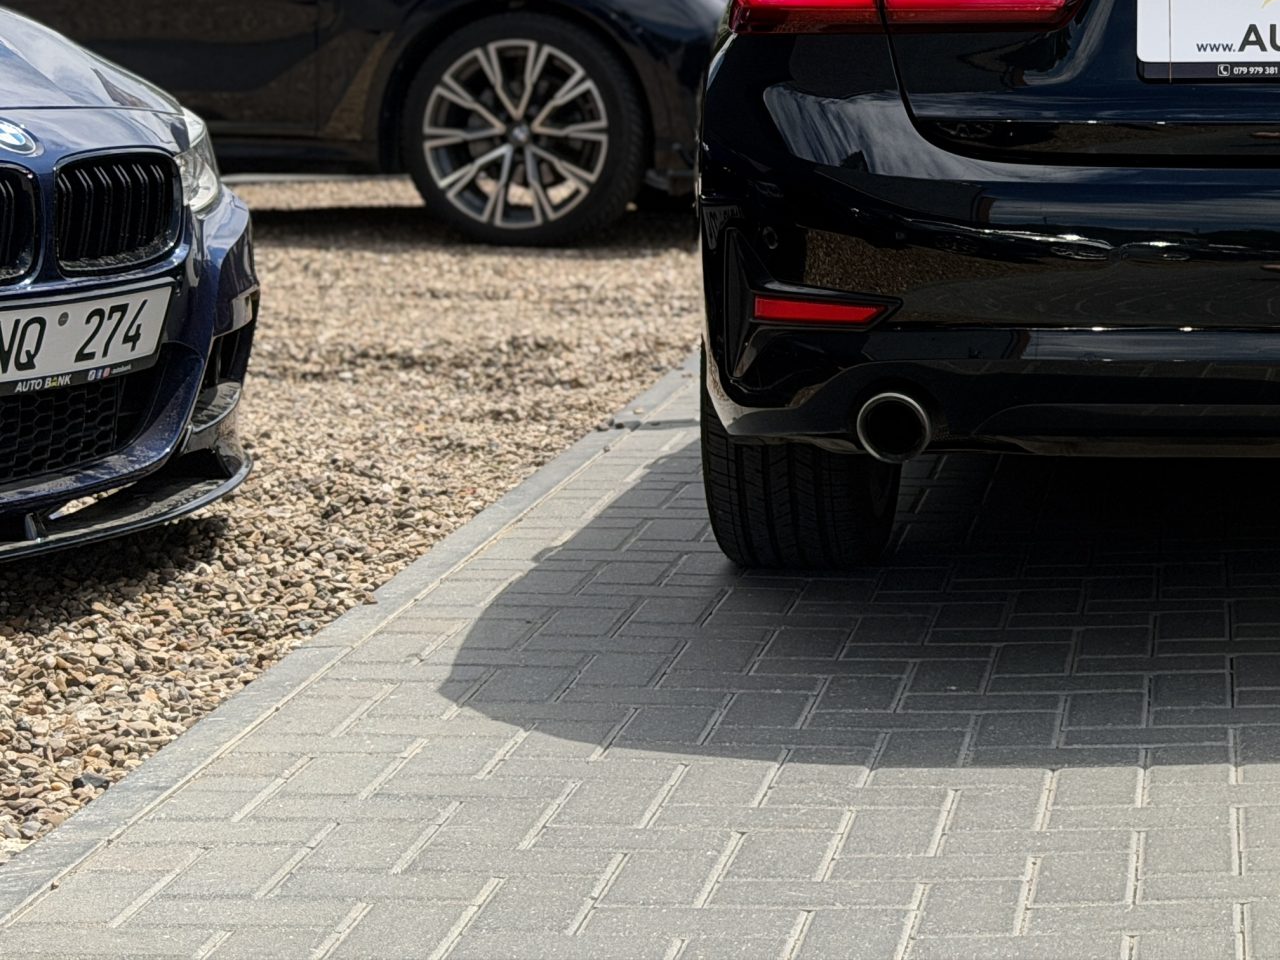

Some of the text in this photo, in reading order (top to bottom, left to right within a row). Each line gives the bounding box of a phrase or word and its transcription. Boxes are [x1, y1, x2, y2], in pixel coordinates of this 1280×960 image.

[1233, 66, 1278, 75] 079 979 381
[74, 299, 148, 363] 274
[15, 377, 43, 393] AUTO
